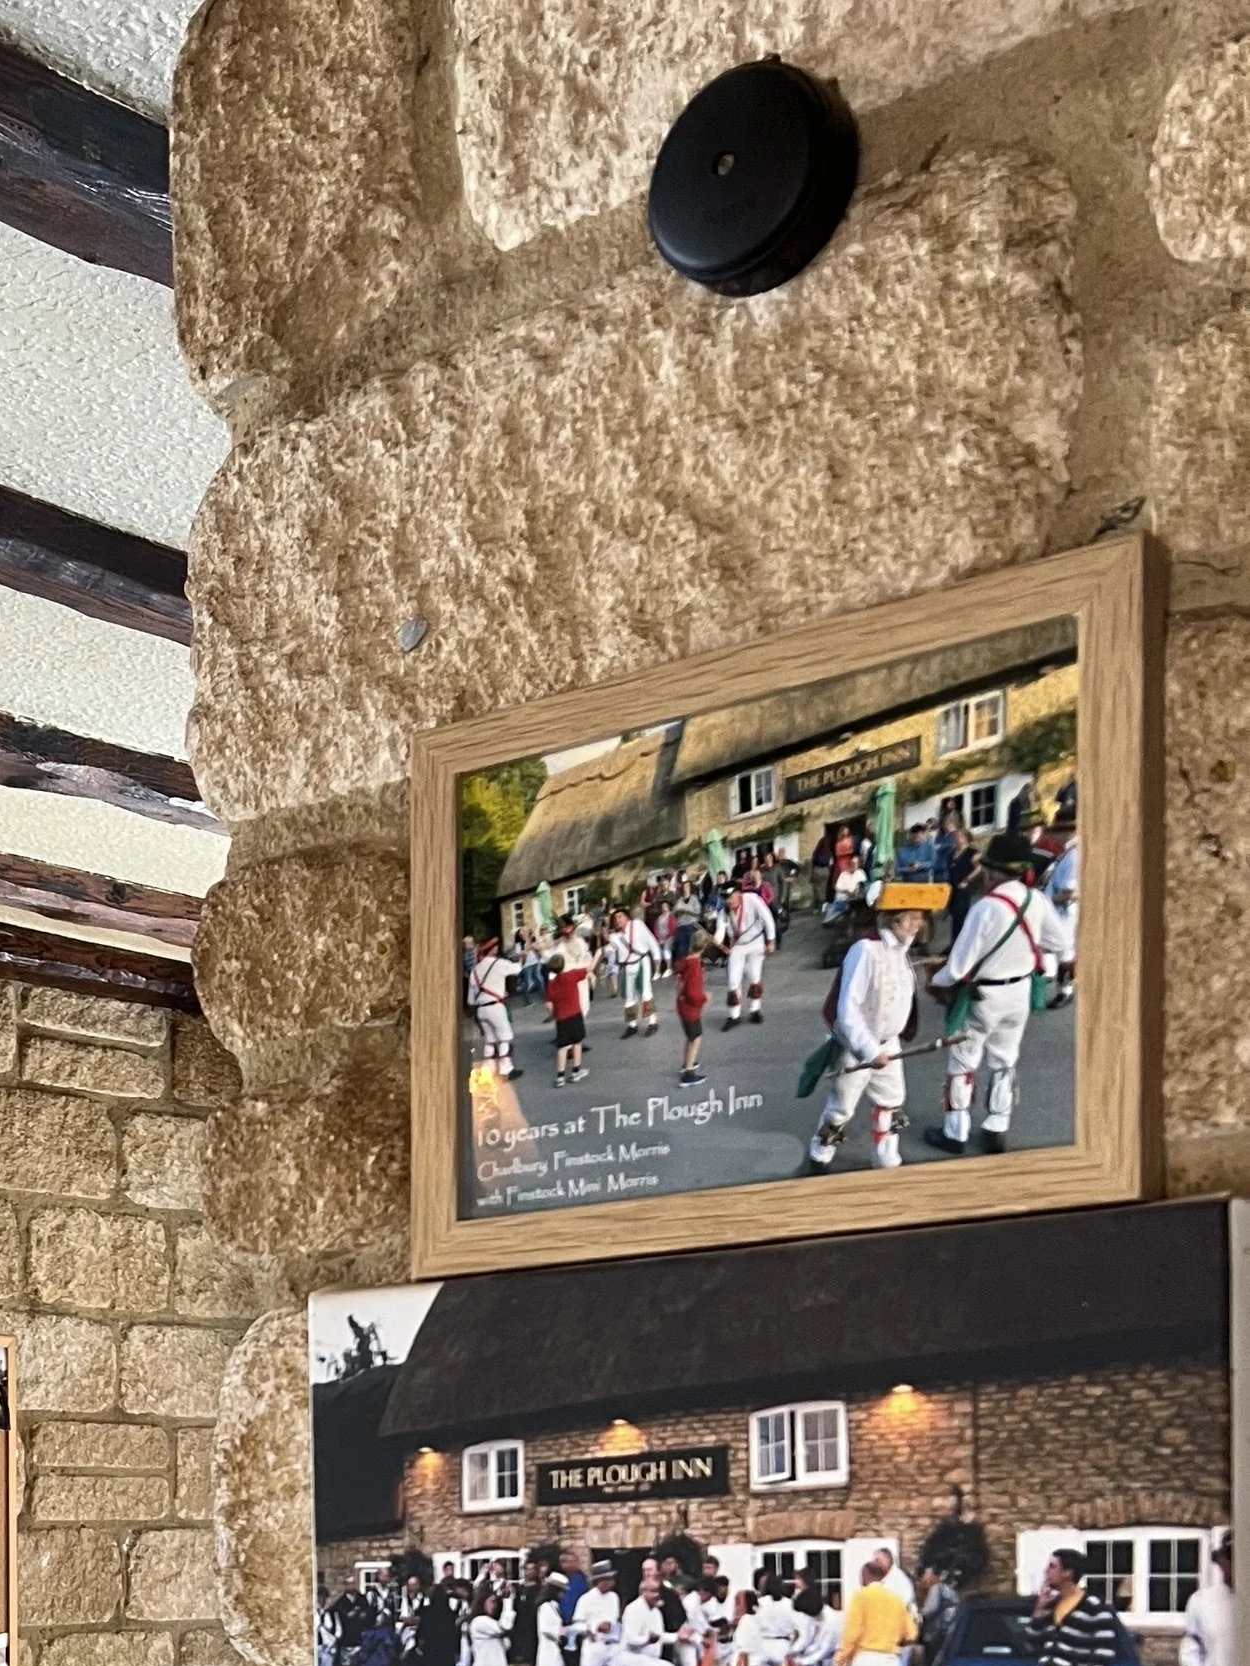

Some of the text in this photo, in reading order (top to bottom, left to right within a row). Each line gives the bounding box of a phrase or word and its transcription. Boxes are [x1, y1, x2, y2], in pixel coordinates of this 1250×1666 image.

[823, 755, 879, 783] PLOUGH
[478, 1085, 764, 1152] 10 years at The Plough Inn
[476, 1141, 671, 1182] Charlbury Finstock Morris
[476, 1171, 659, 1207] with Finstock Mini Morris
[549, 1467, 585, 1490] THE
[587, 1460, 667, 1487] PLOUGH
[672, 1456, 713, 1480] INN
